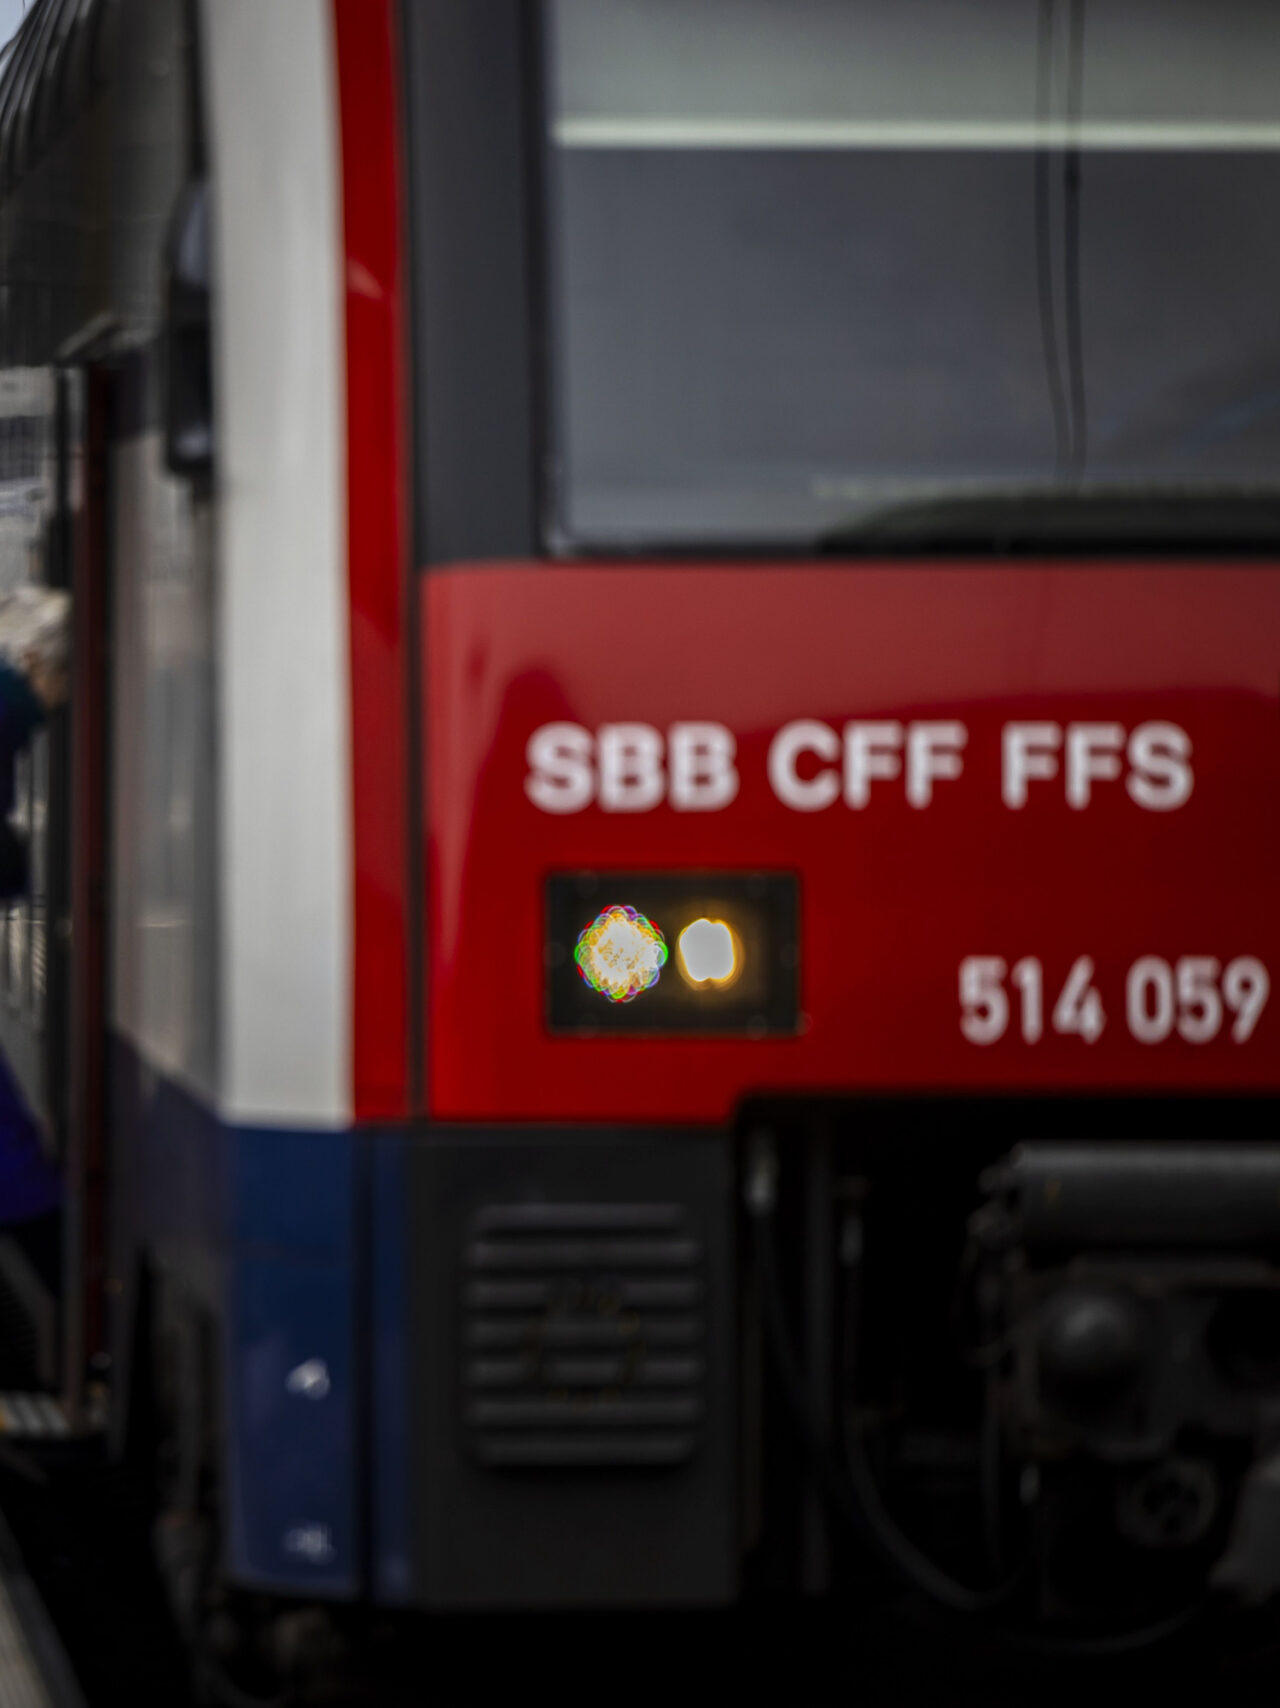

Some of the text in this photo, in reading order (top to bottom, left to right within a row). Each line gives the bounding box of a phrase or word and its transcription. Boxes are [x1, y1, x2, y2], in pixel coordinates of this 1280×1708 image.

[523, 718, 1195, 815] SBB CFF FFS
[958, 954, 1271, 1046] 514 059
